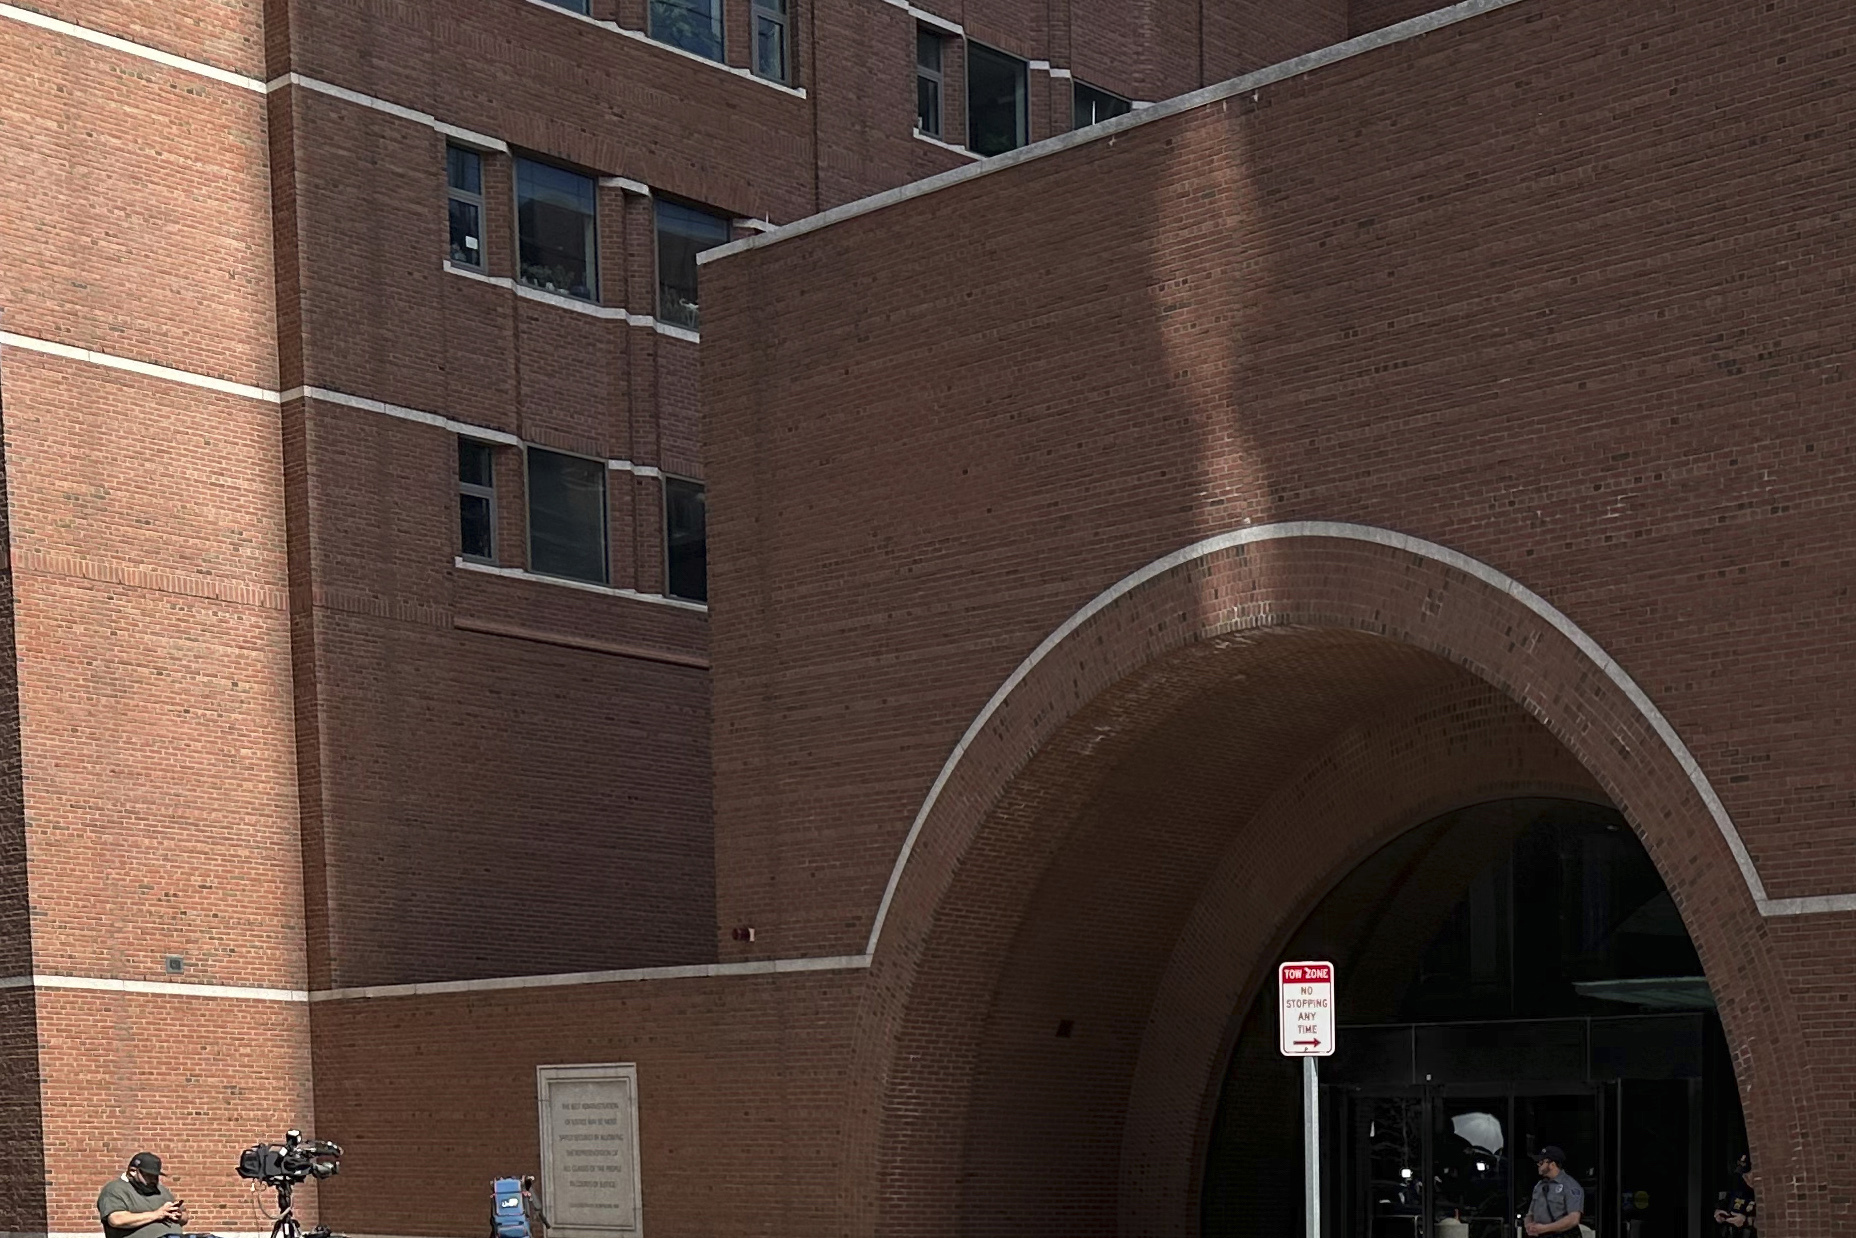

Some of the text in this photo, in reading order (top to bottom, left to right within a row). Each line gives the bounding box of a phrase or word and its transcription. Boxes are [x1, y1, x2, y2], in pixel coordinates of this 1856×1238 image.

[1284, 967, 1329, 979] TOW ZONE
[1300, 986, 1313, 996] NO
[1286, 998, 1328, 1009] STOPPING
[1297, 1011, 1317, 1022] ANY
[1297, 1024, 1318, 1035] TIME
